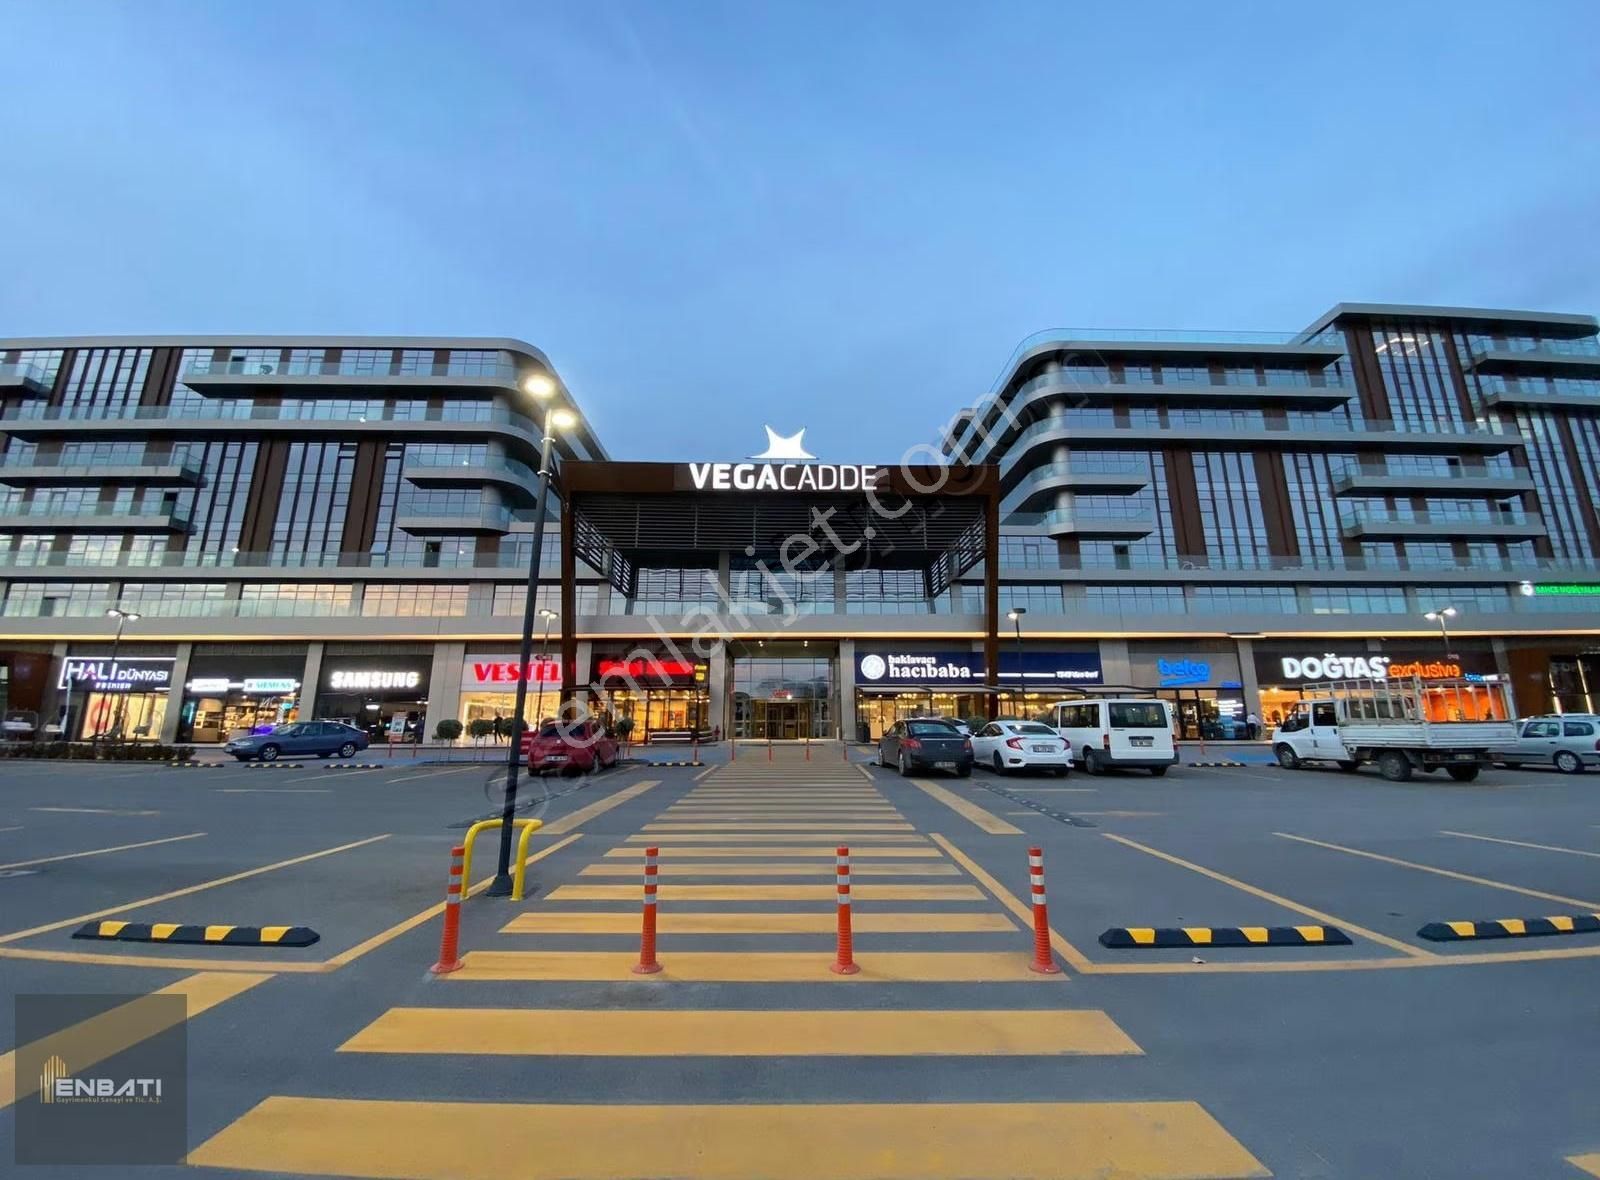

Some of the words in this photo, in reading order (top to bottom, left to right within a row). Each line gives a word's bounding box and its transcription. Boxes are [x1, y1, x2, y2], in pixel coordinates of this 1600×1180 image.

[689, 463, 877, 490] VEGACADDE
[66, 662, 118, 680] HALI
[117, 668, 168, 681] DÜNYASI
[1388, 661, 1461, 678] exclusive
[330, 671, 418, 689] SAMSUNG
